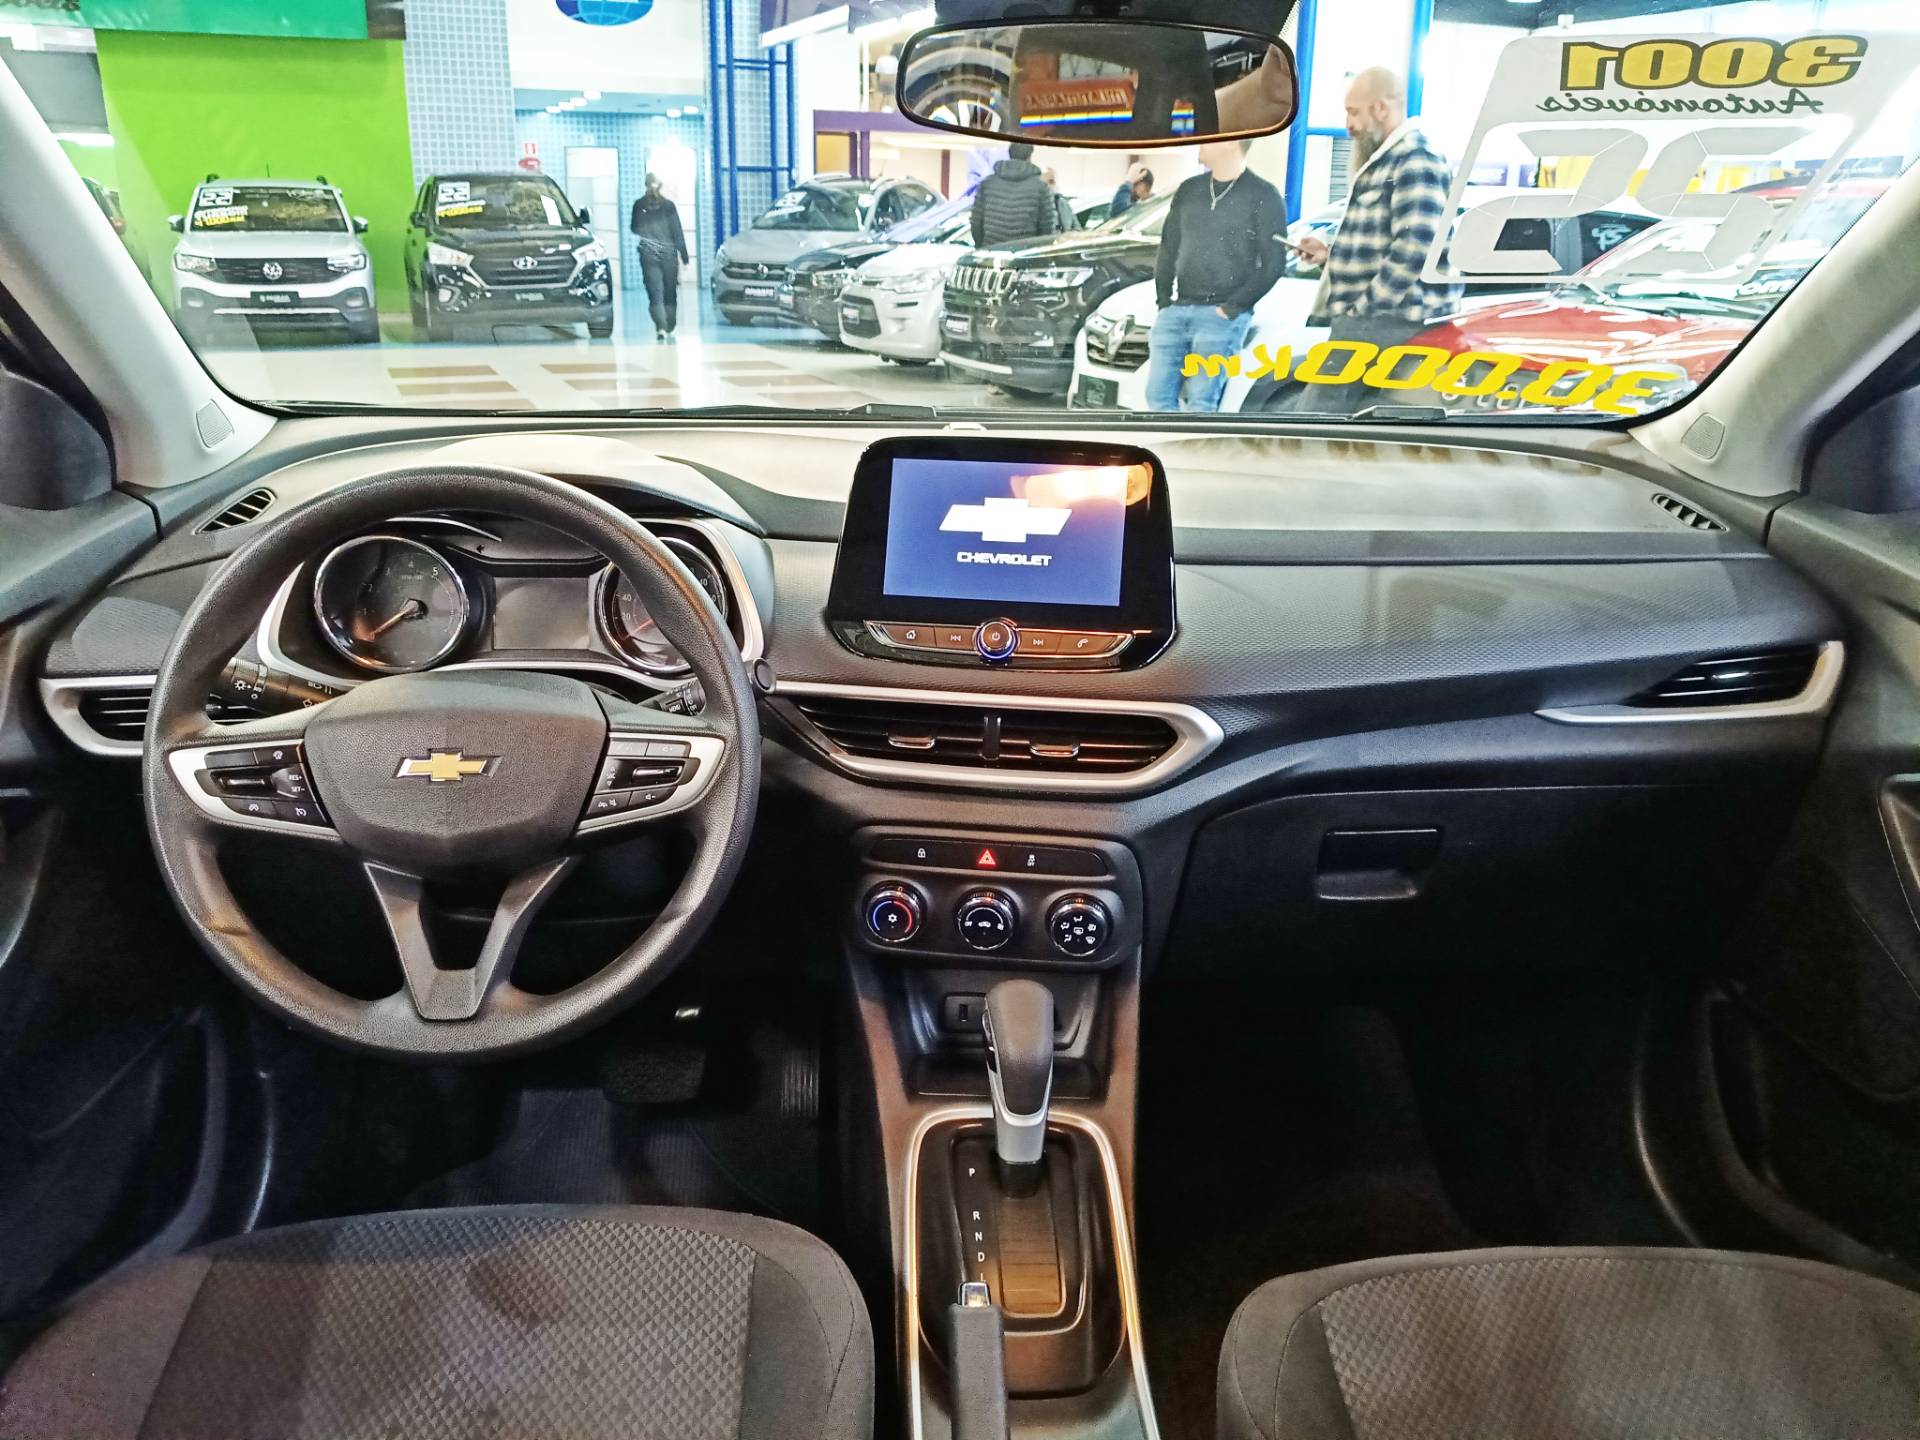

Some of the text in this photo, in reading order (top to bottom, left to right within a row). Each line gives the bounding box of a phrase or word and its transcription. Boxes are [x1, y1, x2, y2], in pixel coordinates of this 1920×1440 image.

[956, 551, 1053, 567] CHEVROLET
[968, 1168, 976, 1177] P
[973, 1210, 981, 1221] R
[975, 1231, 983, 1241] N
[977, 1252, 985, 1263] D
